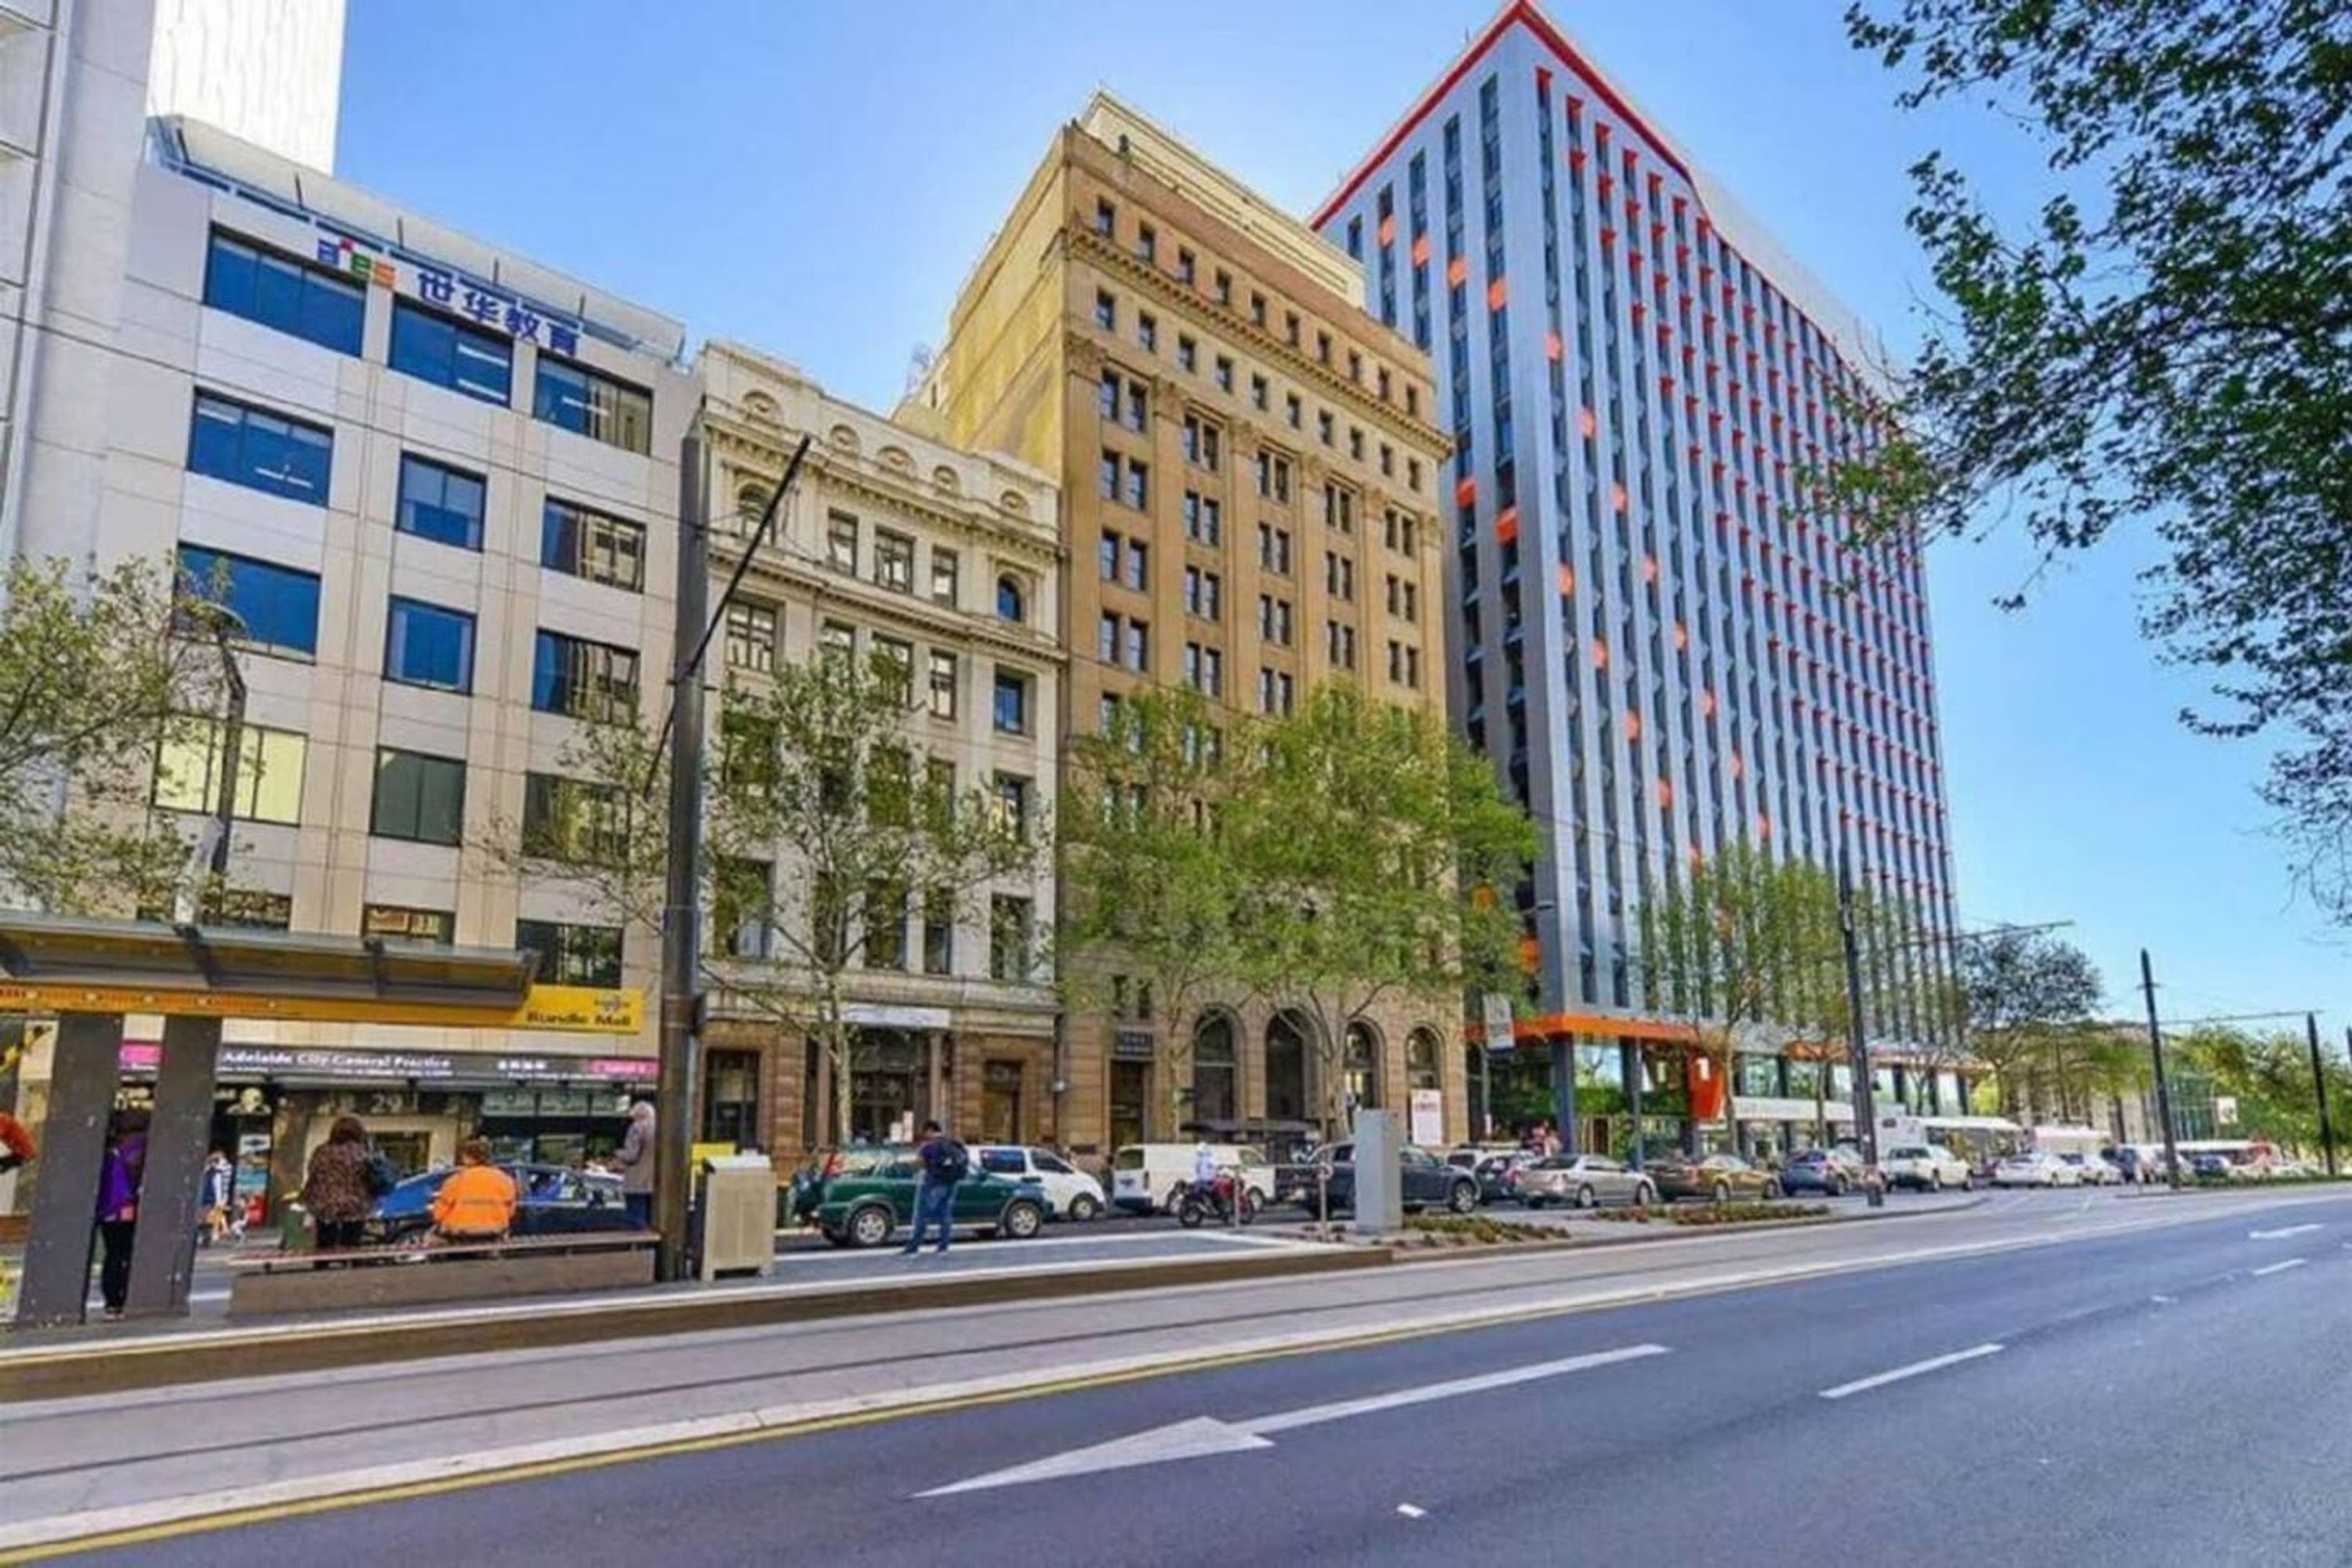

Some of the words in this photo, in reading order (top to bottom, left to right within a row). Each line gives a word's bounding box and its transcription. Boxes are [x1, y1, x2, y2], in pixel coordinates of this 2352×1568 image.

[419, 272, 581, 357] 世华教育
[527, 1011, 588, 1024] Rundle
[594, 1014, 631, 1026] Mall
[223, 1051, 294, 1065] Adelaide
[296, 1053, 329, 1067] City
[332, 1054, 392, 1068] General
[394, 1055, 452, 1069] Practice
